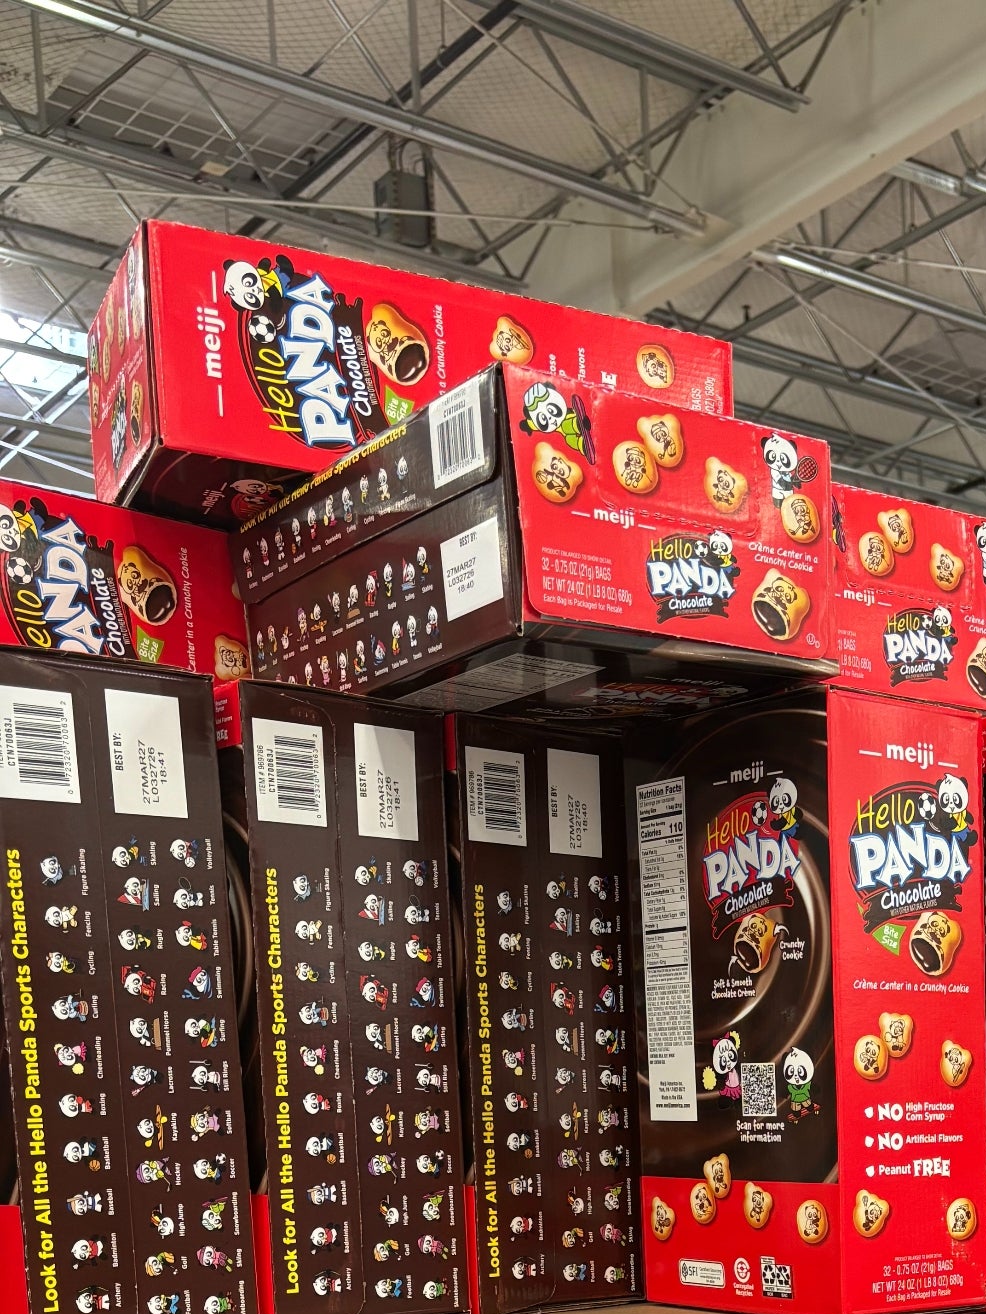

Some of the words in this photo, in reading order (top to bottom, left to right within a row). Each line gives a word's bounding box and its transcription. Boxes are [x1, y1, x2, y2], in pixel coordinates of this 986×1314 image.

[203, 306, 225, 379] meiji
[300, 272, 358, 450] PANDA
[340, 325, 373, 418] Chocolate
[267, 347, 290, 435] Hello
[594, 508, 635, 530] meiji
[447, 557, 476, 578] 27MAR27
[448, 569, 475, 587] L032726
[647, 558, 736, 598] PANDA
[755, 554, 786, 568] Crunchy
[787, 560, 814, 573] Cookie
[884, 629, 953, 664] PANDA
[7, 717, 16, 767] CTN70063J
[113, 732, 122, 746] BY:
[885, 743, 934, 769] meiji
[115, 747, 124, 771] BEST
[138, 739, 151, 805] 27MAR27
[149, 747, 160, 804] L032726
[730, 760, 764, 784] meiji
[857, 796, 916, 834] Hello
[703, 829, 801, 901] PANDA
[850, 821, 972, 890] PANDA
[779, 939, 805, 953] Crunchy
[782, 949, 803, 961] Cookie
